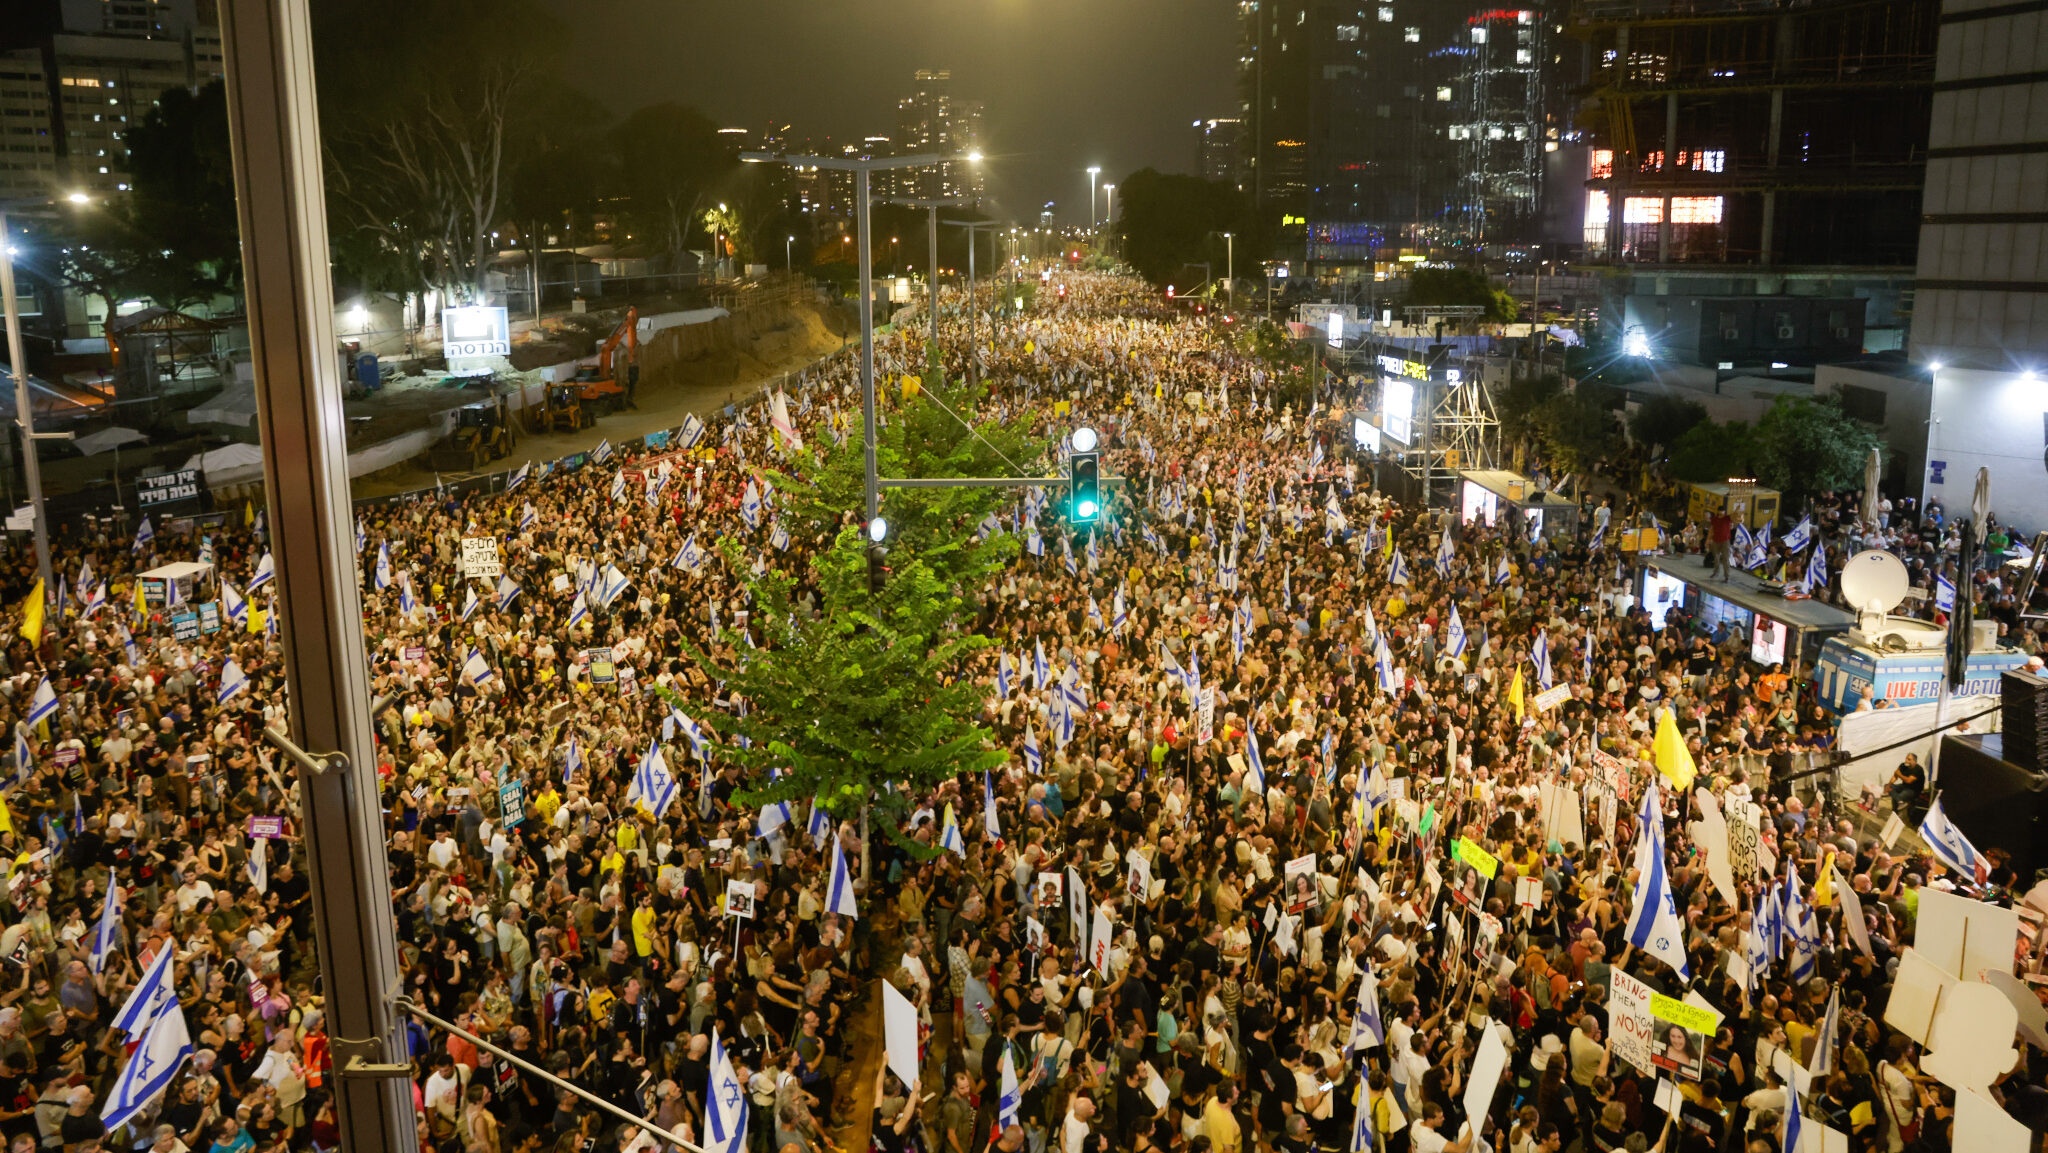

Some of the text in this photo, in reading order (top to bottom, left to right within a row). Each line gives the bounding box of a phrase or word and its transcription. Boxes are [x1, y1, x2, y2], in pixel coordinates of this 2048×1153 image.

[451, 342, 507, 356] הנדסה
[146, 470, 196, 488] אין מחיר
[139, 483, 198, 503] גבוה מידי
[1886, 681, 1918, 699] LIVE
[502, 787, 521, 804] SEAL
[505, 799, 520, 814] THE
[1734, 799, 1748, 820] 64
[504, 808, 523, 826] DEAL
[1614, 973, 1648, 1000] BRING
[1612, 989, 1636, 1009] THEM
[1634, 1012, 1653, 1029] HOM
